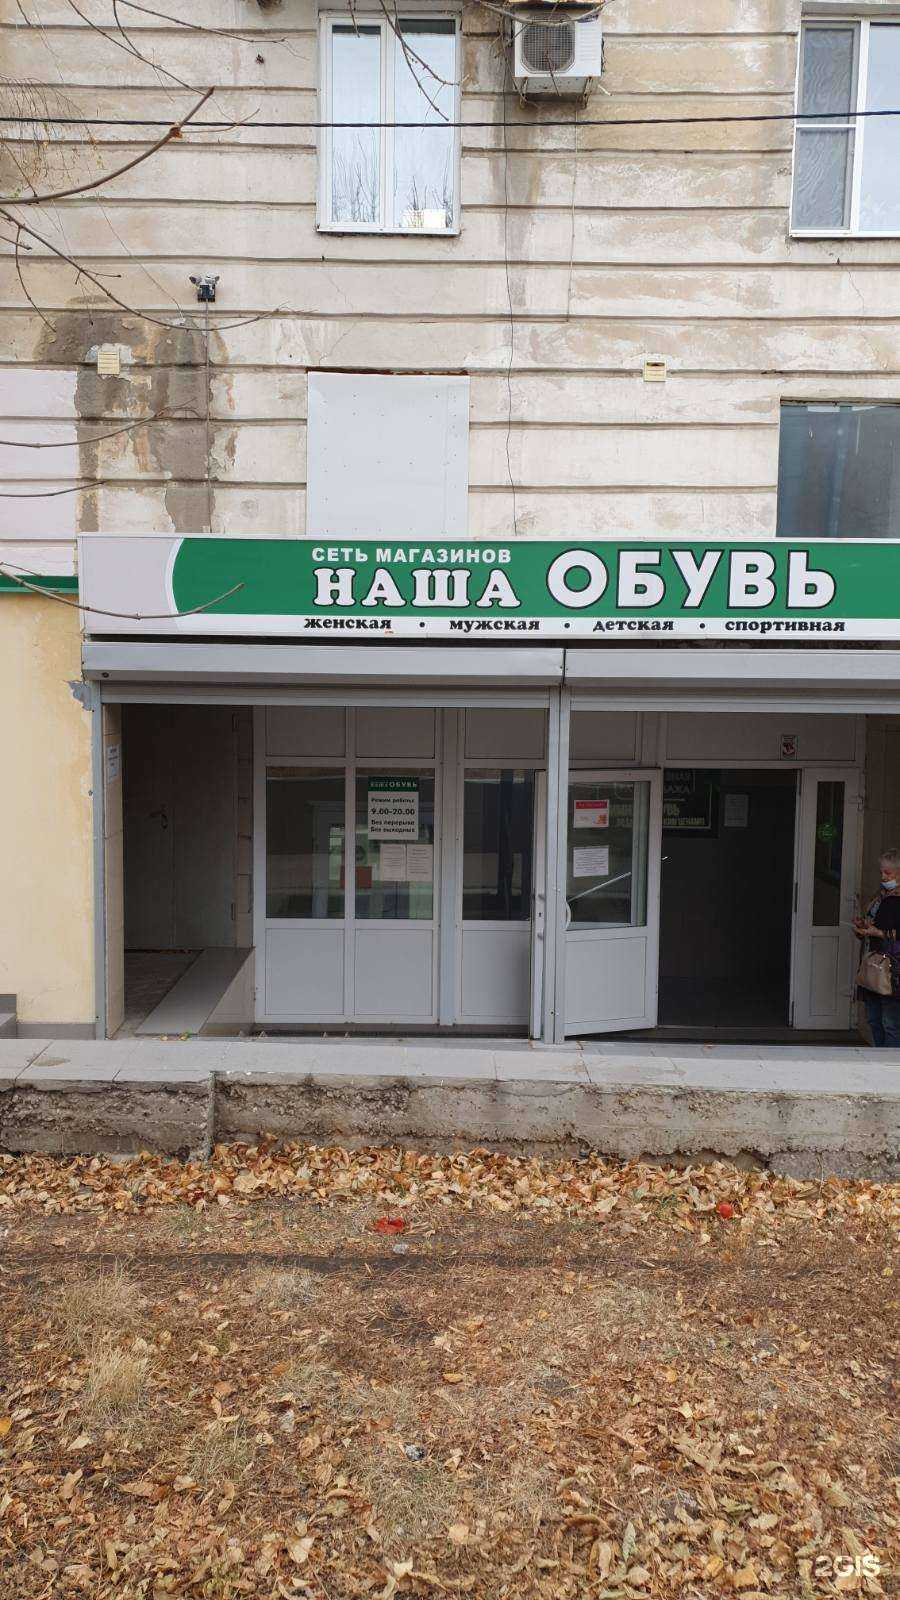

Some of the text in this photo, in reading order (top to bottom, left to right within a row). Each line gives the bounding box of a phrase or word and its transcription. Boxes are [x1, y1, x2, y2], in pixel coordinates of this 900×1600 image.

[311, 547, 511, 563] СЕТЬ МАГАЗИНОВ
[313, 548, 837, 609] НАША ОБУВЬ
[303, 618, 845, 633] женская мужская детская спортивная
